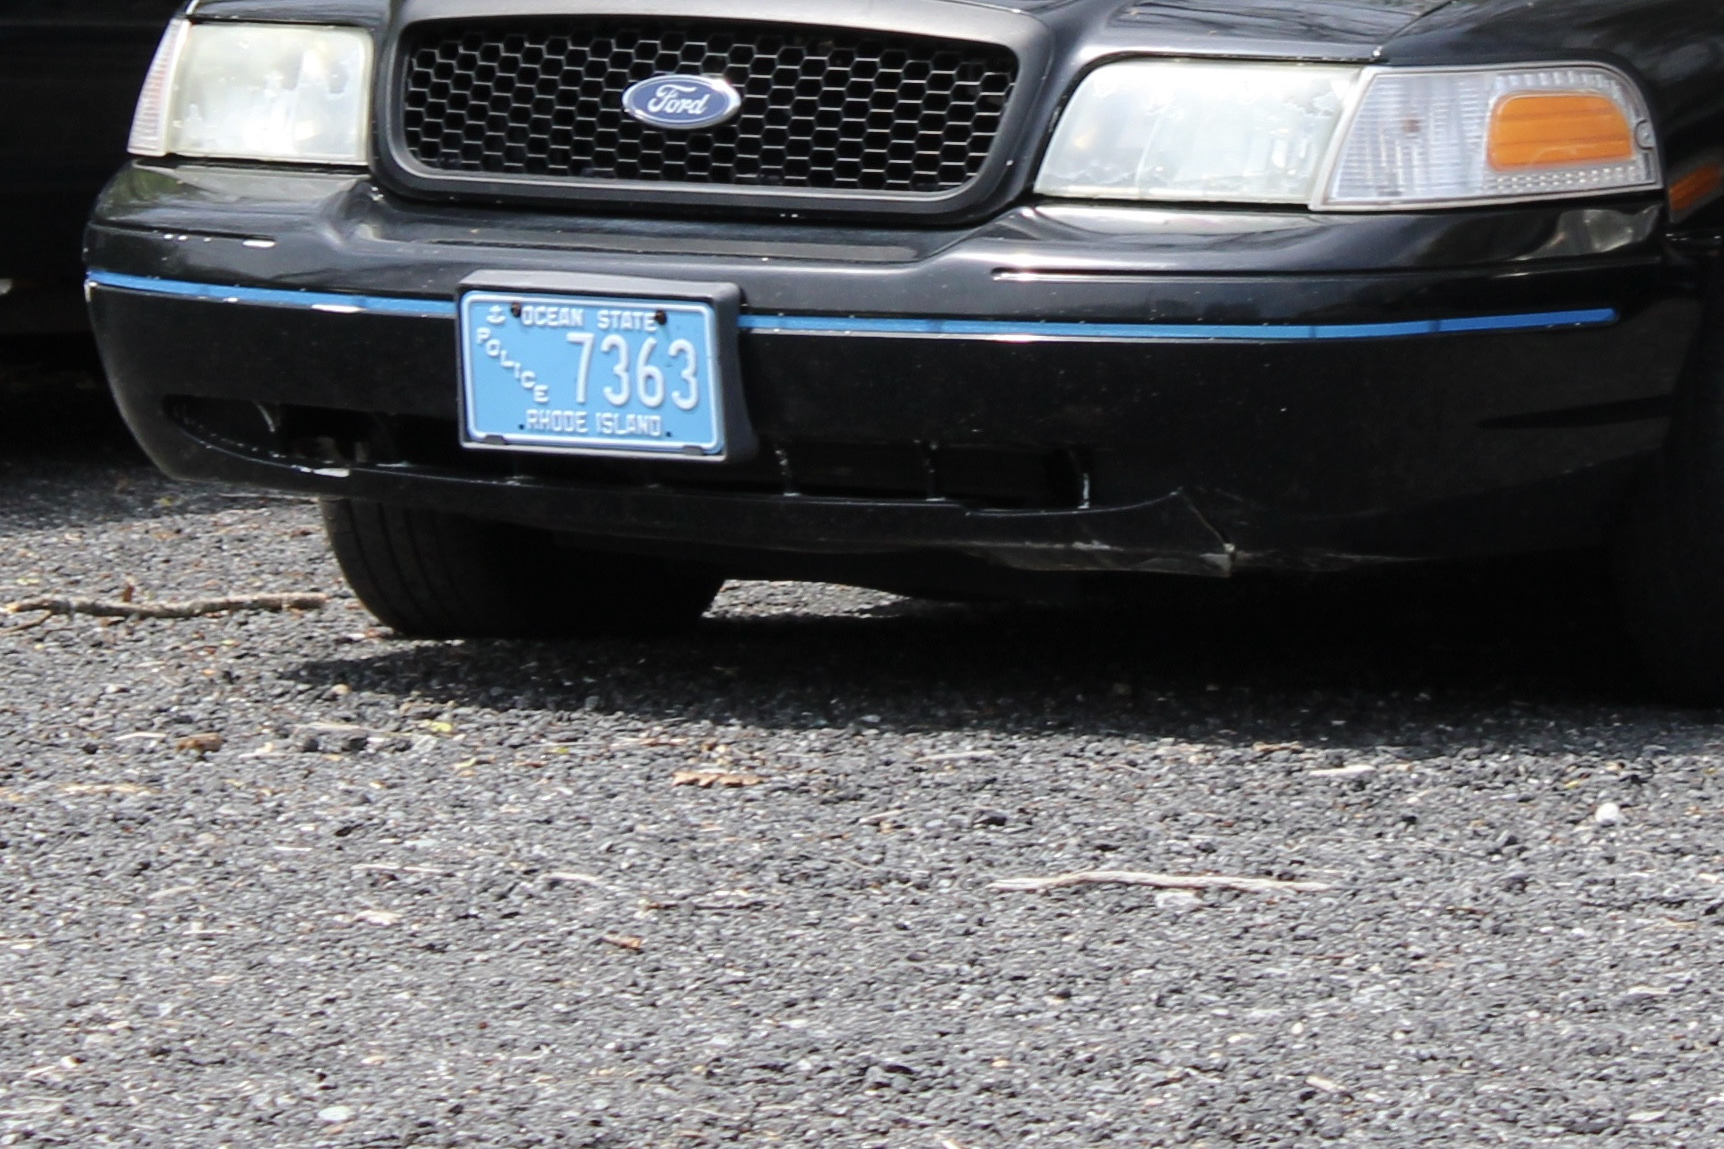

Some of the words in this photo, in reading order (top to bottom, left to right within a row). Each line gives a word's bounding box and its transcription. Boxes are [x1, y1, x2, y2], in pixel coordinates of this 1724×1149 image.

[648, 84, 710, 115] Ford
[521, 305, 584, 327] OCEAN
[597, 310, 657, 332] STATE
[476, 327, 549, 403] POLICE
[566, 332, 698, 411] 7363
[525, 409, 588, 433] RHODE
[596, 413, 662, 437] ISLAND
